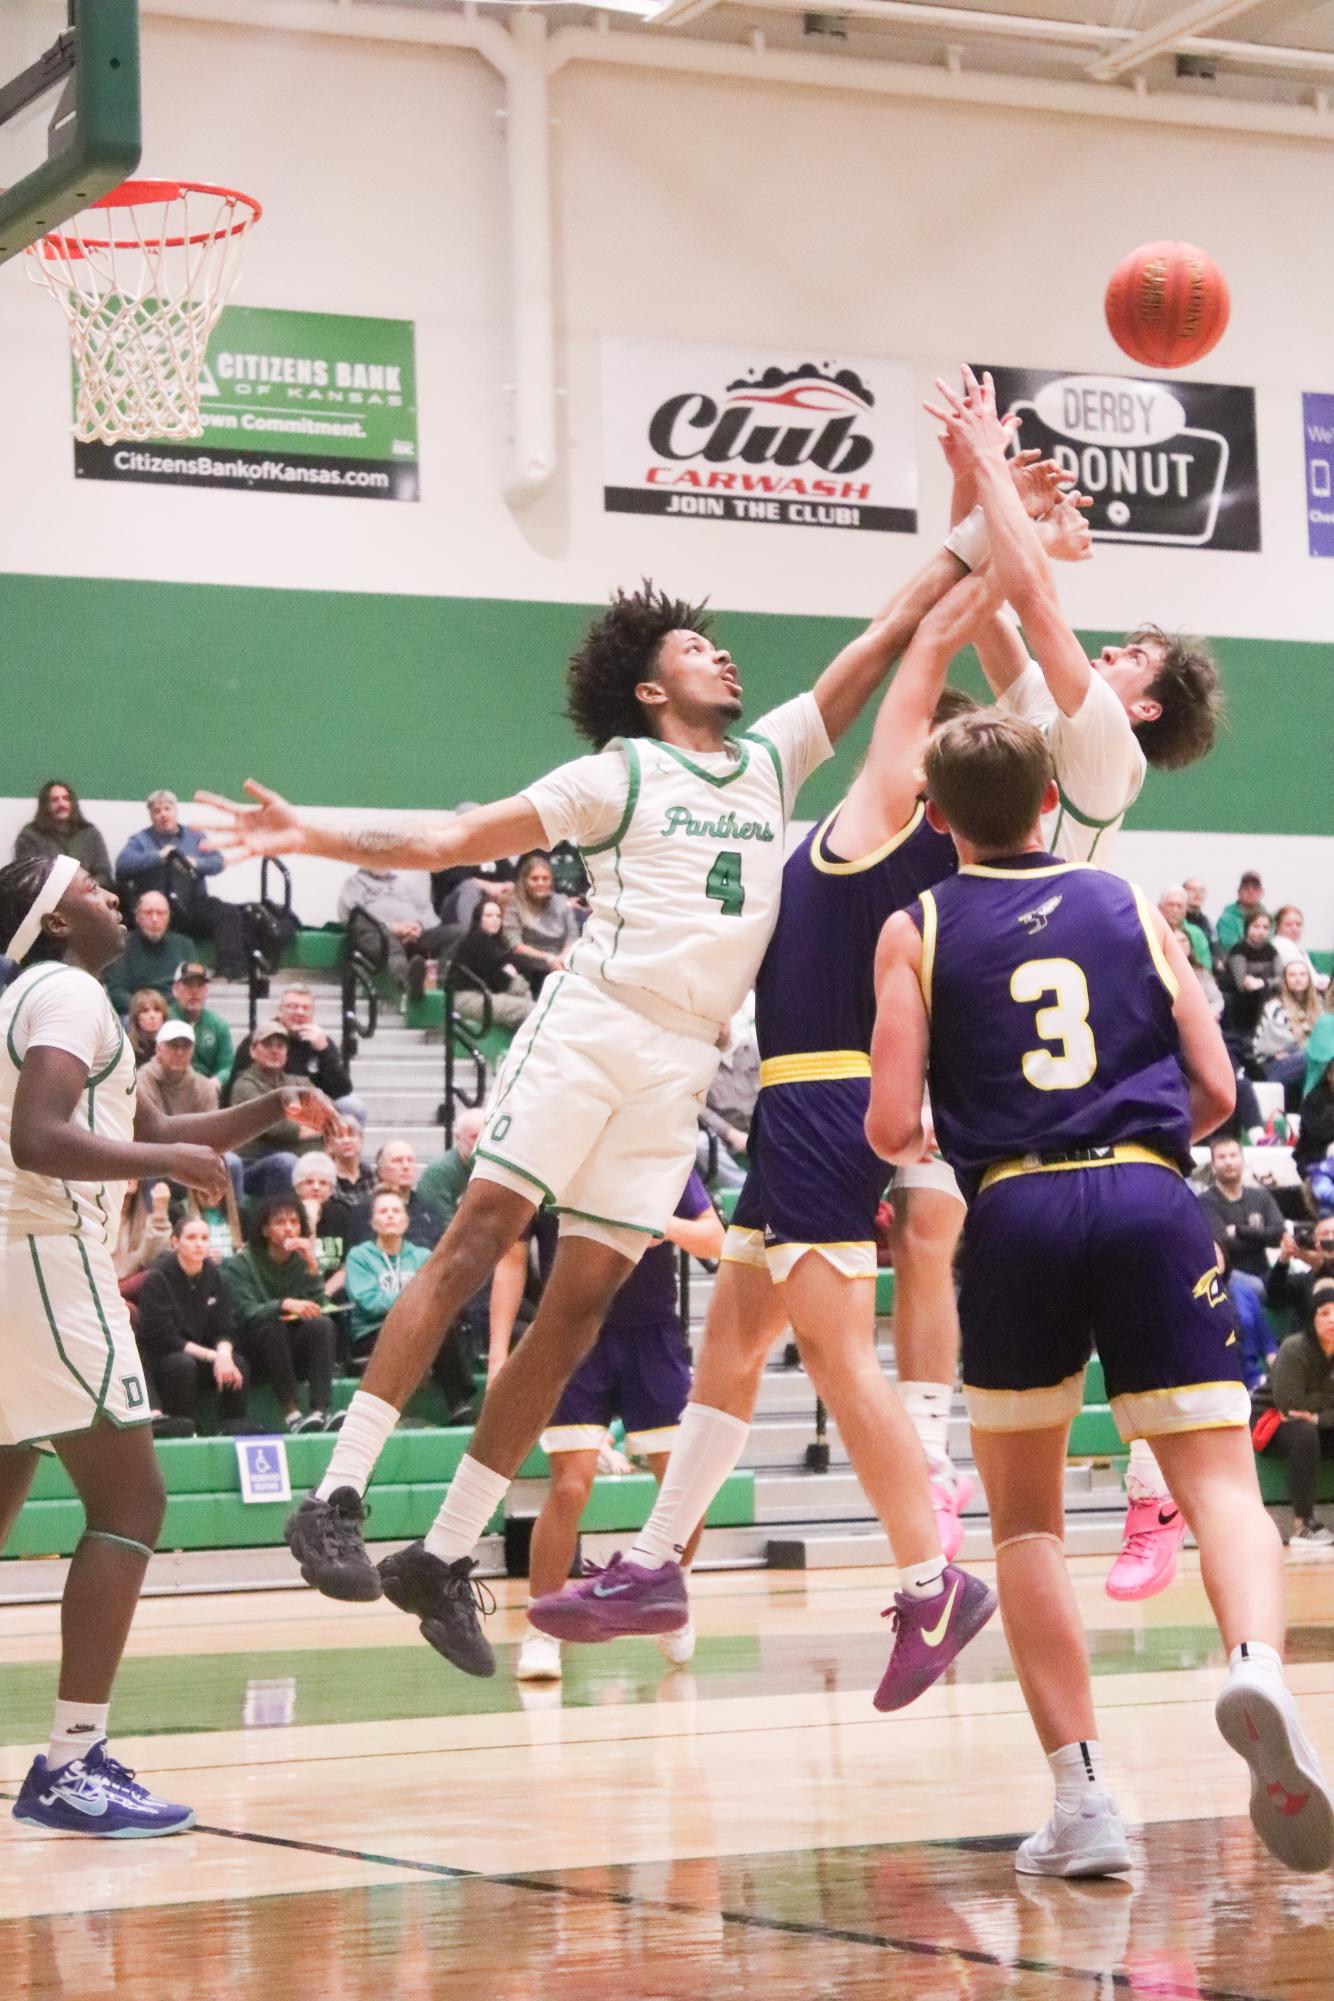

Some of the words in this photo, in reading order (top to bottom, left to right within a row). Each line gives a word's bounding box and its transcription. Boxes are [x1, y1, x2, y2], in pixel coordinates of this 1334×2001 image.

[217, 353, 328, 386] CITIZENS
[336, 362, 402, 391] BANK
[235, 383, 272, 395] OF
[288, 388, 403, 406] KANSAS
[1062, 387, 1157, 435] DERBY
[242, 413, 367, 437] Commitment.
[648, 392, 875, 475] Club
[113, 451, 390, 487] CitizensBankofKansas.com
[645, 467, 872, 500] CARWASH
[1053, 444, 1195, 498] DONUT
[666, 495, 725, 517] JOIN
[733, 499, 781, 521] THE
[788, 502, 861, 526] CLUB!
[660, 806, 775, 842] Panthers
[705, 850, 745, 917] 4
[1010, 957, 1097, 1091] 3
[119, 1374, 145, 1410] D
